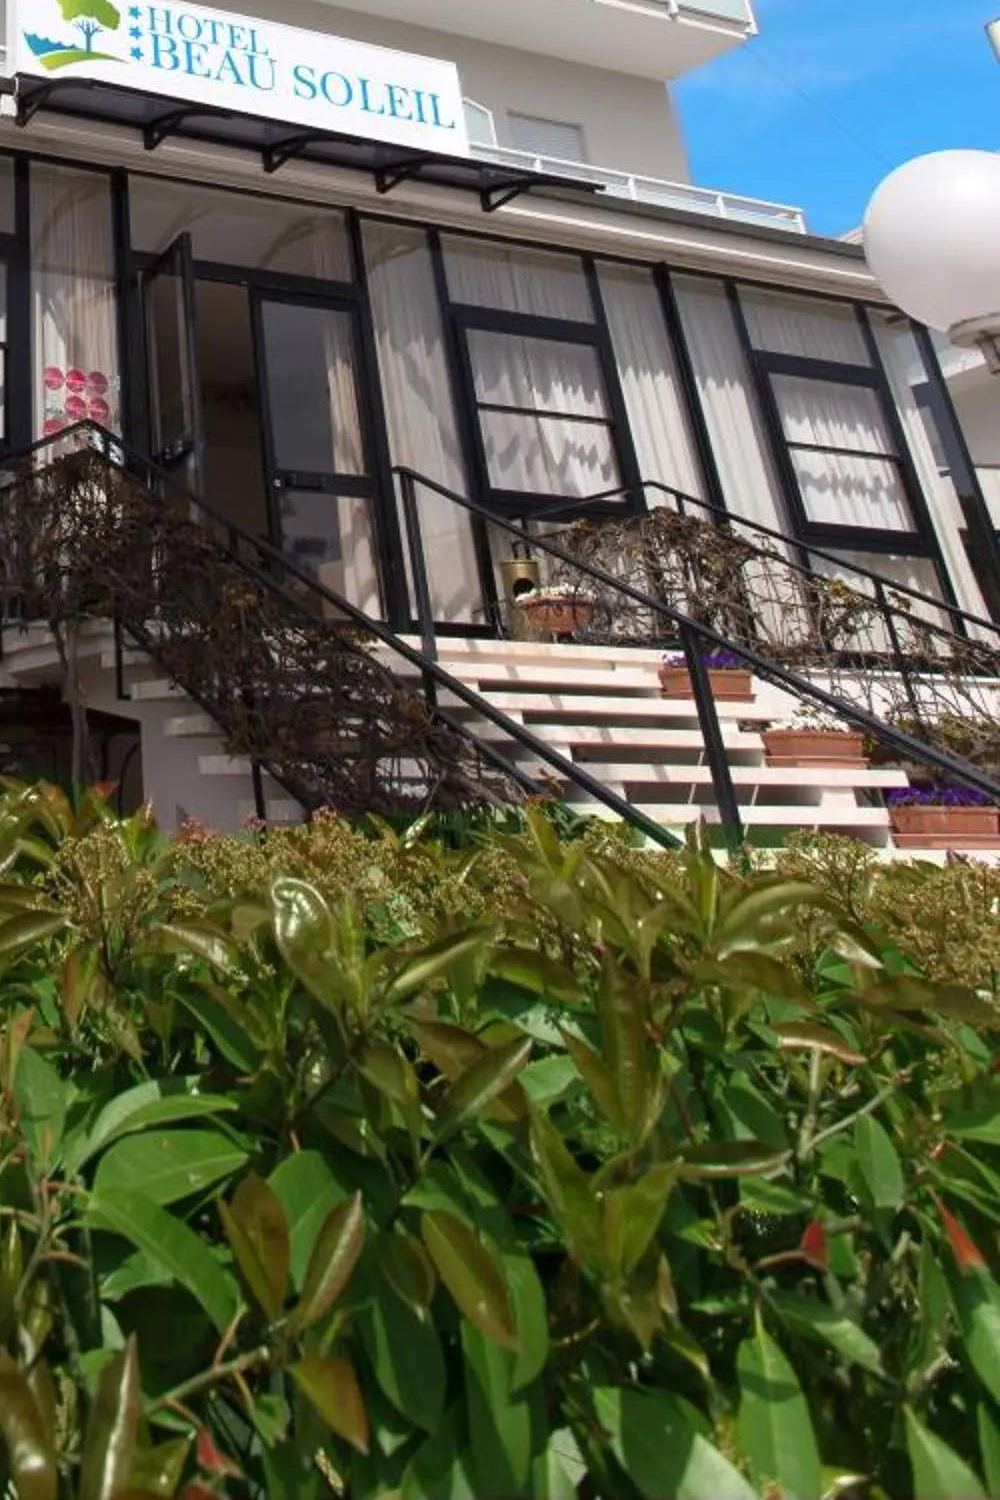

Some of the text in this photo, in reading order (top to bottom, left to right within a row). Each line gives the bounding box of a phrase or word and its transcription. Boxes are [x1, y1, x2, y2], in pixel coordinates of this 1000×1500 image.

[148, 6, 269, 56] HOTEL
[152, 35, 456, 129] BEAU SOLEIL
